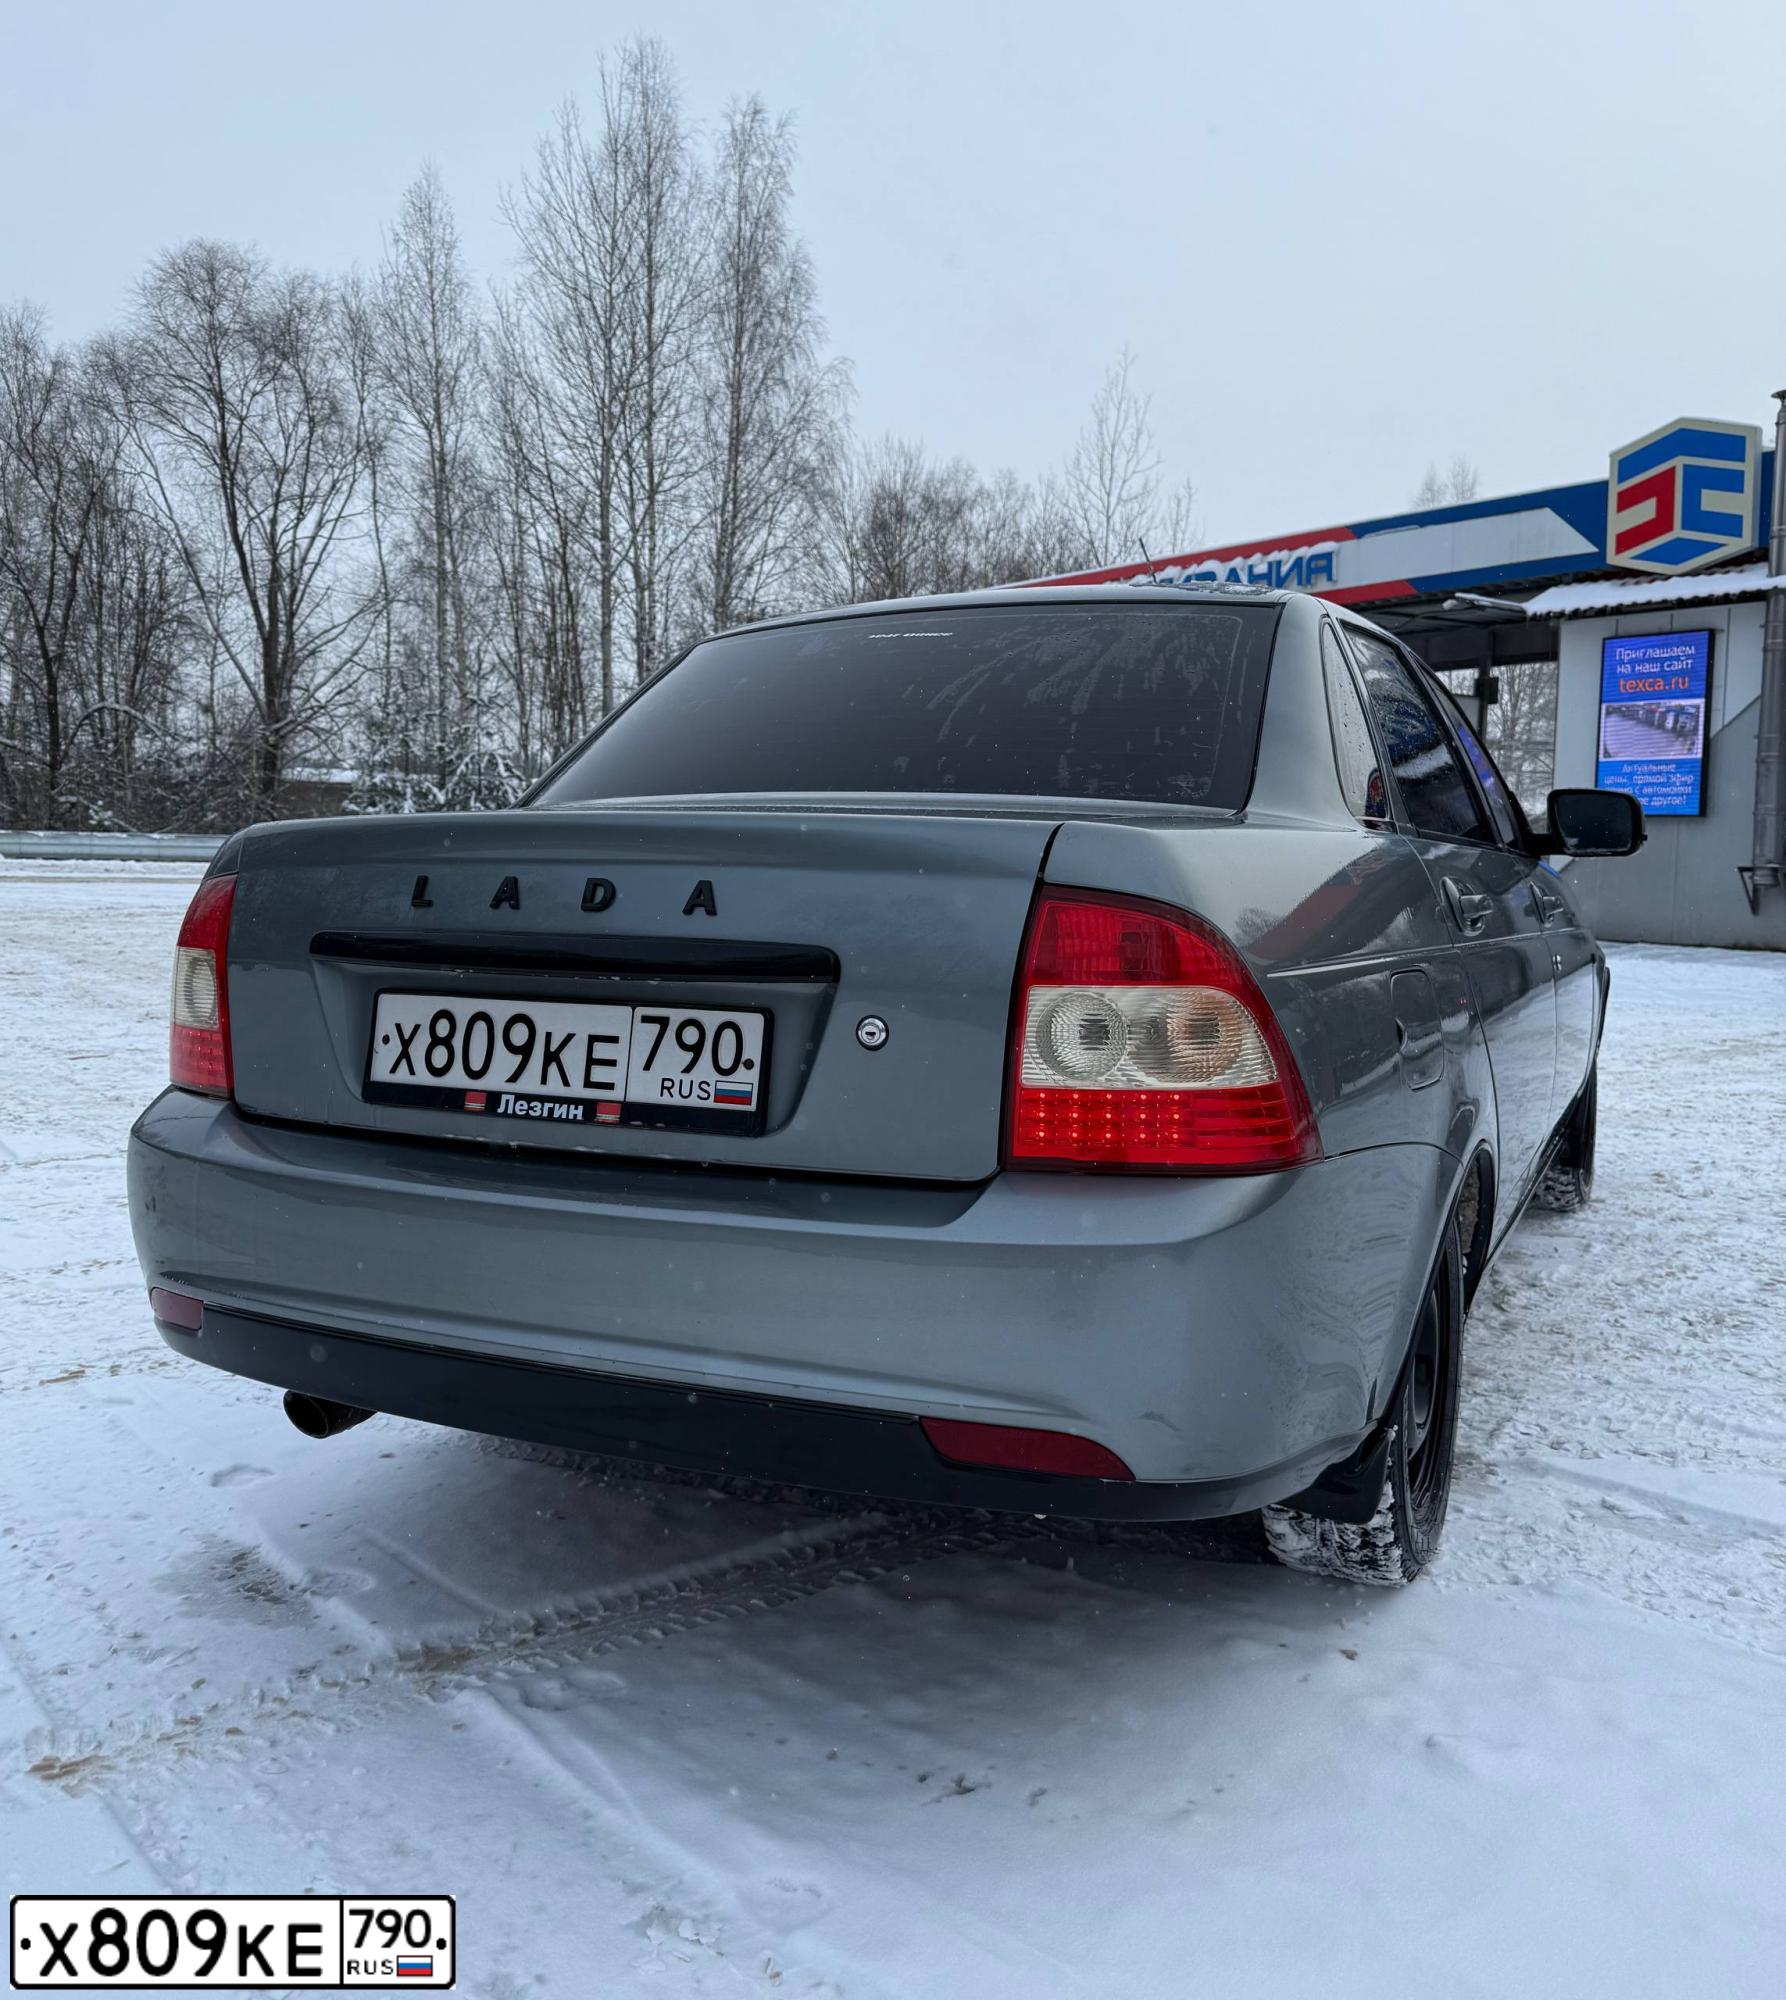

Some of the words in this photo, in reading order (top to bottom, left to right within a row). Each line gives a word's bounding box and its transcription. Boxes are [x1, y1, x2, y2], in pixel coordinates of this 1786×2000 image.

[1615, 645, 1696, 662] Приглашаем
[1616, 663, 1631, 674] на
[1635, 661, 1660, 673] наш
[1663, 656, 1694, 672] сайт
[1618, 676, 1690, 694] texca.ru
[411, 875, 718, 917] LADA
[640, 1014, 744, 1078] 790
[659, 1077, 712, 1102] RUS
[496, 1093, 584, 1121] Лезгин
